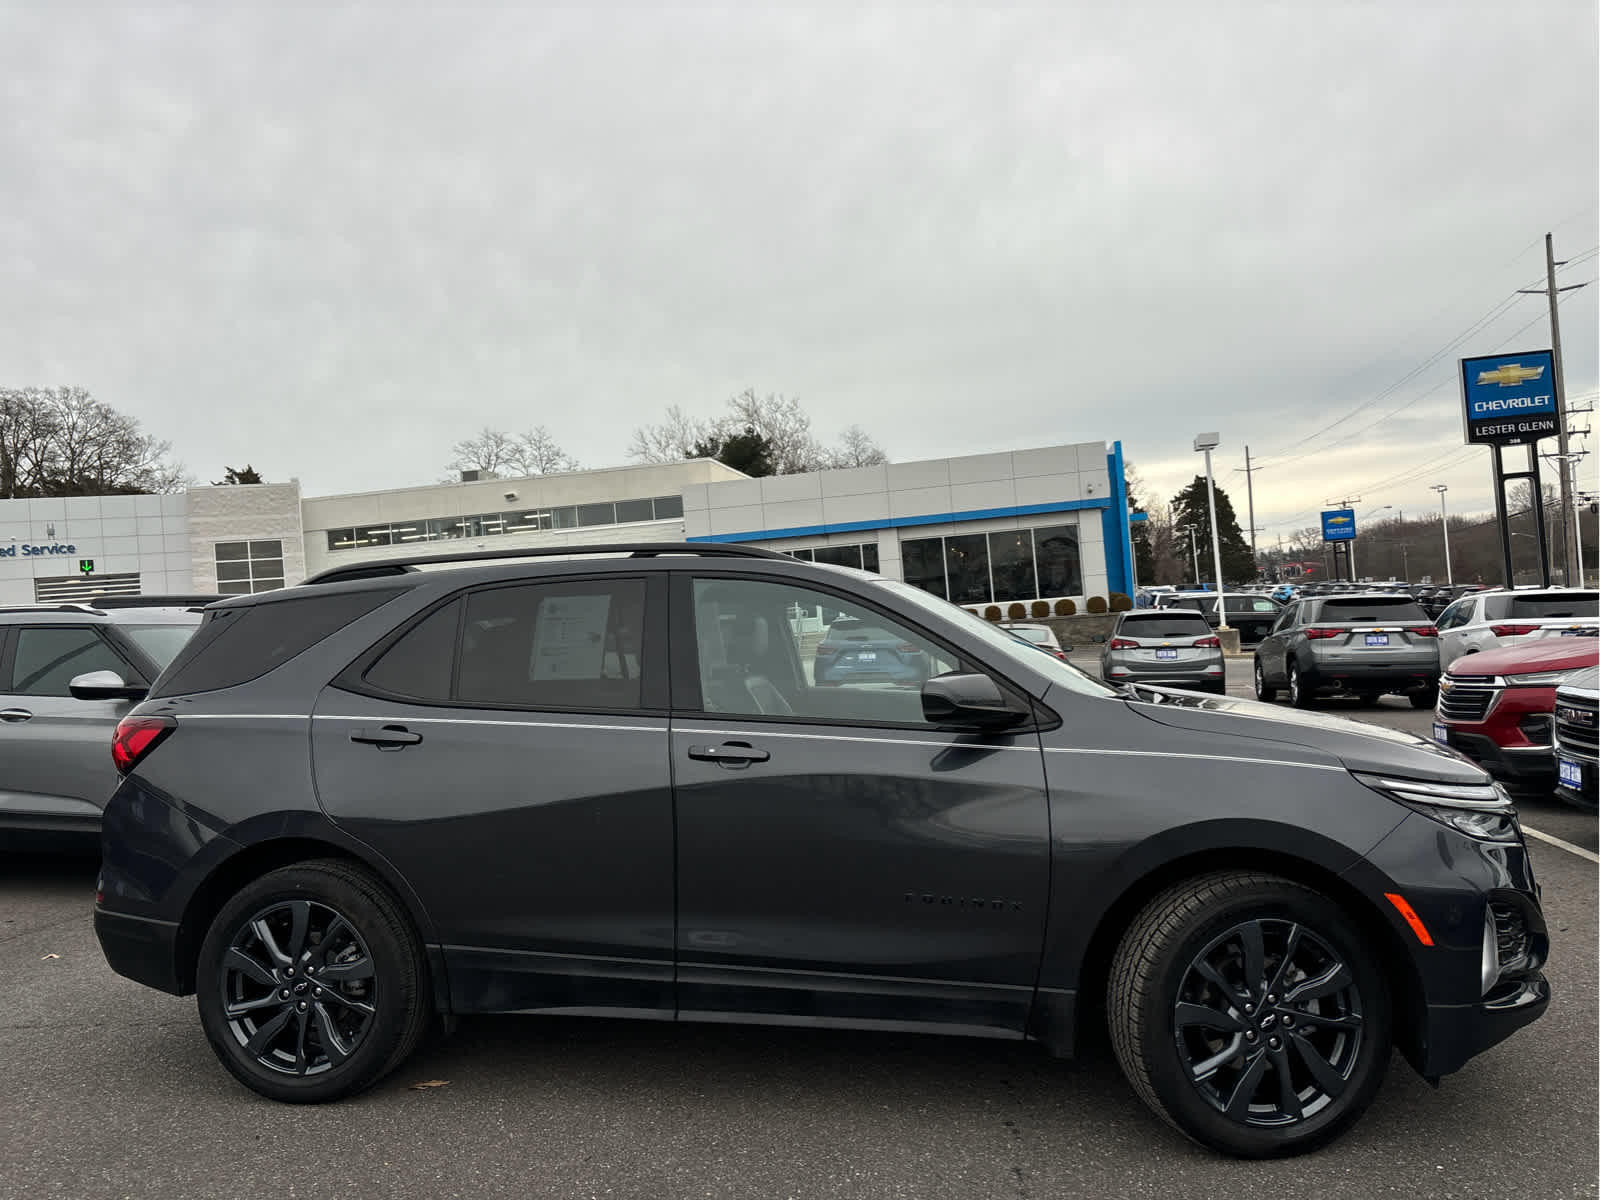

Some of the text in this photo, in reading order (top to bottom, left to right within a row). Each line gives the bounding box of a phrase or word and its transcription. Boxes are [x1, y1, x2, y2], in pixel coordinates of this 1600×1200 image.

[1474, 395, 1550, 412] CHEVROLET
[1475, 420, 1554, 436] LESTER GLENN
[21, 543, 76, 556] Service
